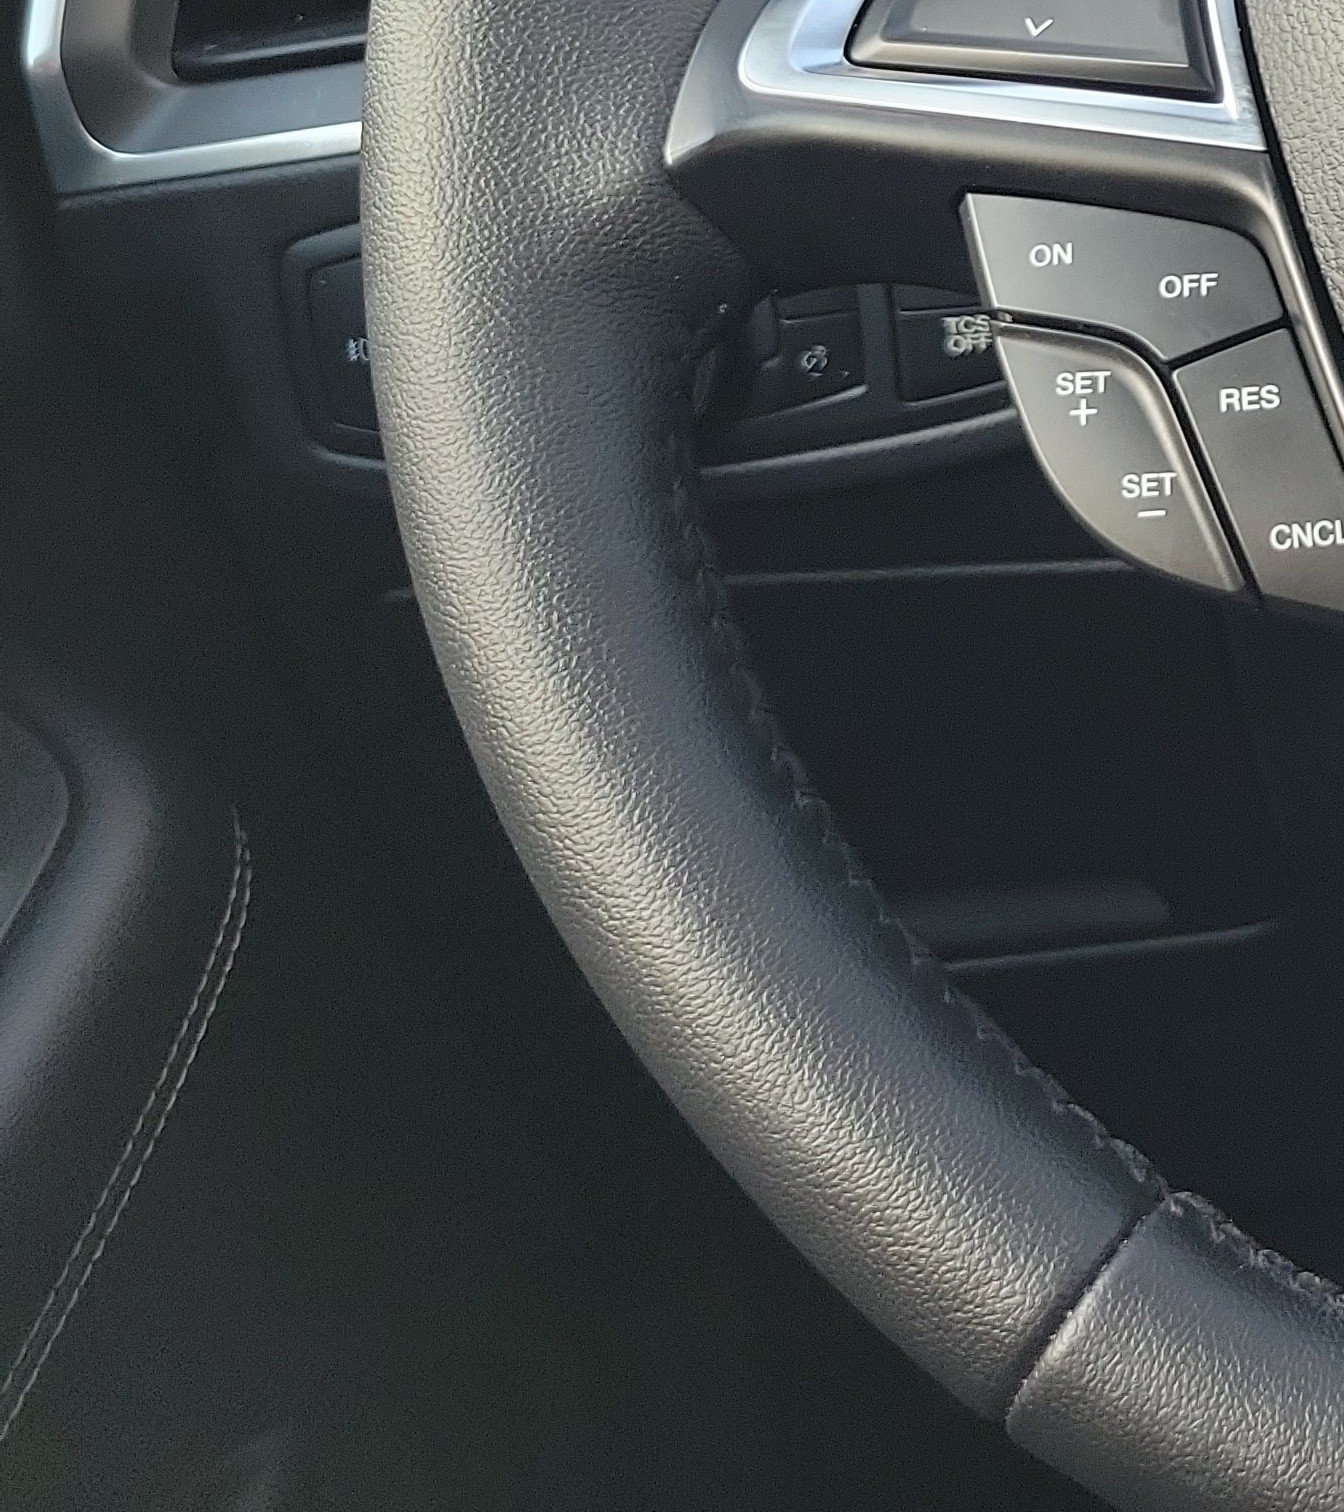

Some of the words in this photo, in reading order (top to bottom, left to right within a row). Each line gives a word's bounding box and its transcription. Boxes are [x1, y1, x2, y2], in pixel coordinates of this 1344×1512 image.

[1029, 241, 1073, 267] ON
[1158, 272, 1219, 299] OFF
[941, 314, 990, 334] TCS
[1055, 371, 1110, 396] SET
[1219, 386, 1280, 412] RES
[1121, 472, 1176, 499] SET
